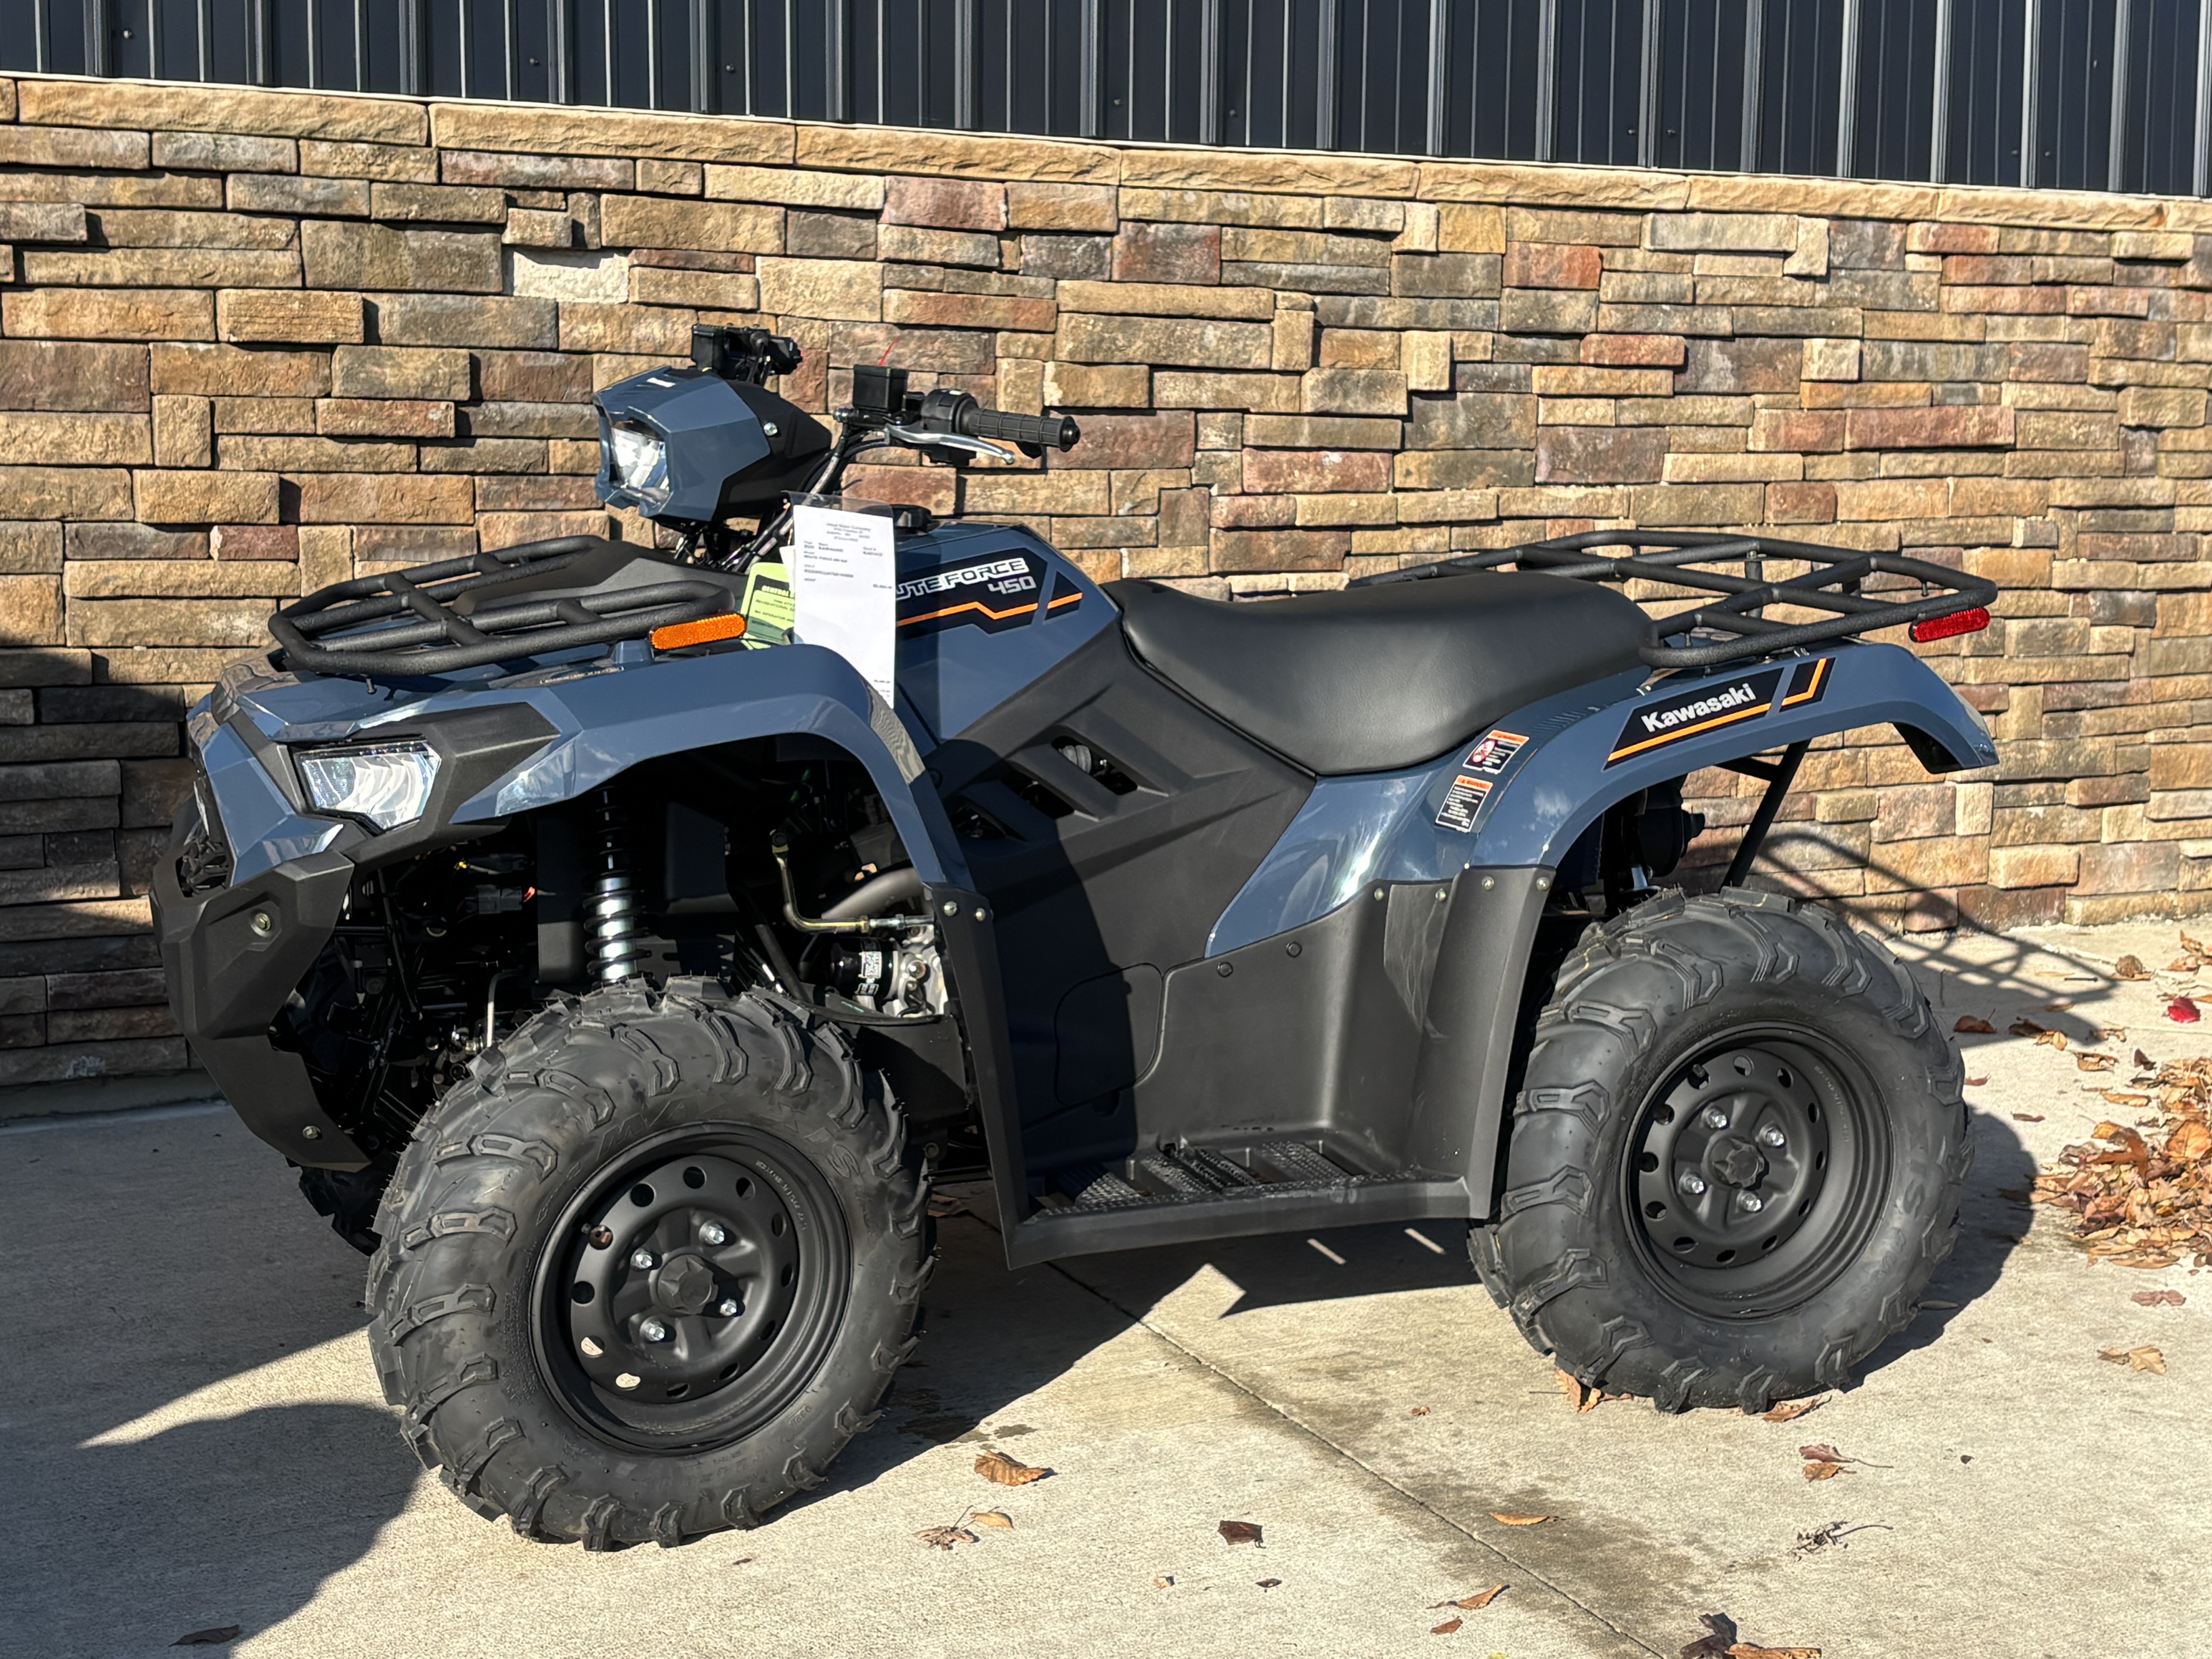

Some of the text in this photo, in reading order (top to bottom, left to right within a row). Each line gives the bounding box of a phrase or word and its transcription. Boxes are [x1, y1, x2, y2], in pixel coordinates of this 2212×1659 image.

[896, 557, 1029, 600] UTE FORCE
[988, 576, 1037, 594] 450
[1641, 683, 1757, 732] Kawasaki
